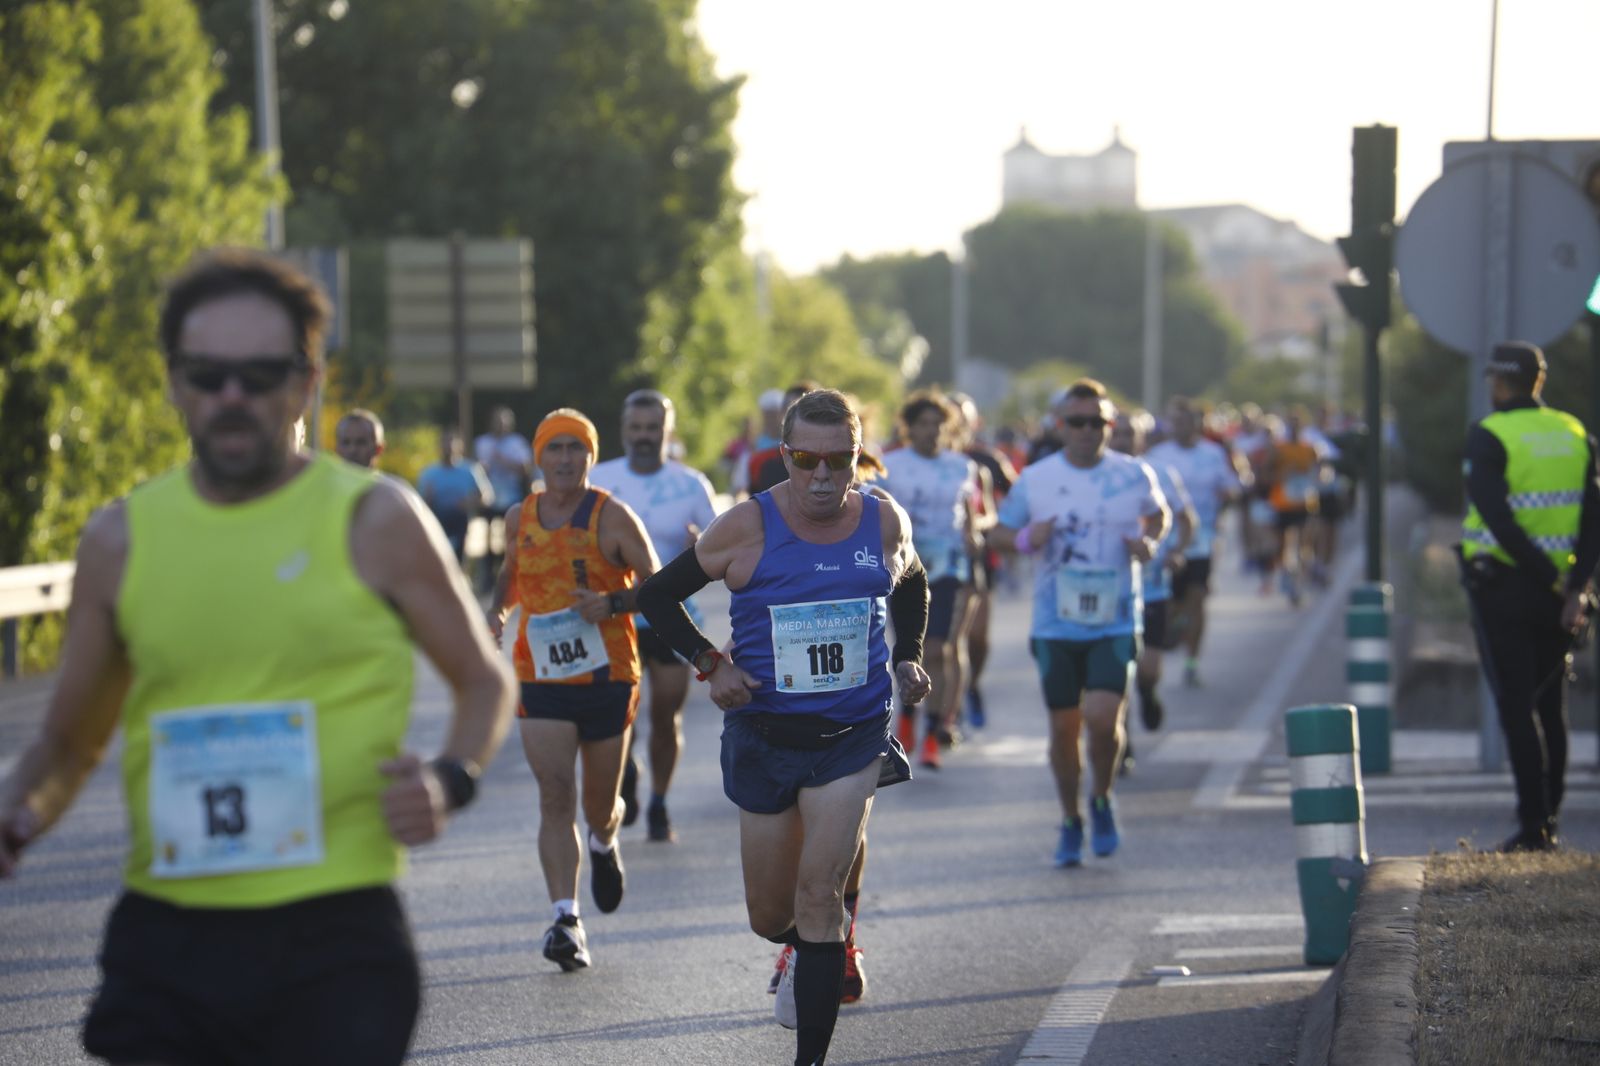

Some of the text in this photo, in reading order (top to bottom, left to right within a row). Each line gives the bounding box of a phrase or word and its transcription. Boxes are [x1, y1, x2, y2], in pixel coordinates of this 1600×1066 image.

[778, 621, 812, 631] MEDIA
[549, 637, 588, 665] 484
[807, 642, 844, 676] 118
[204, 784, 246, 838] 13
